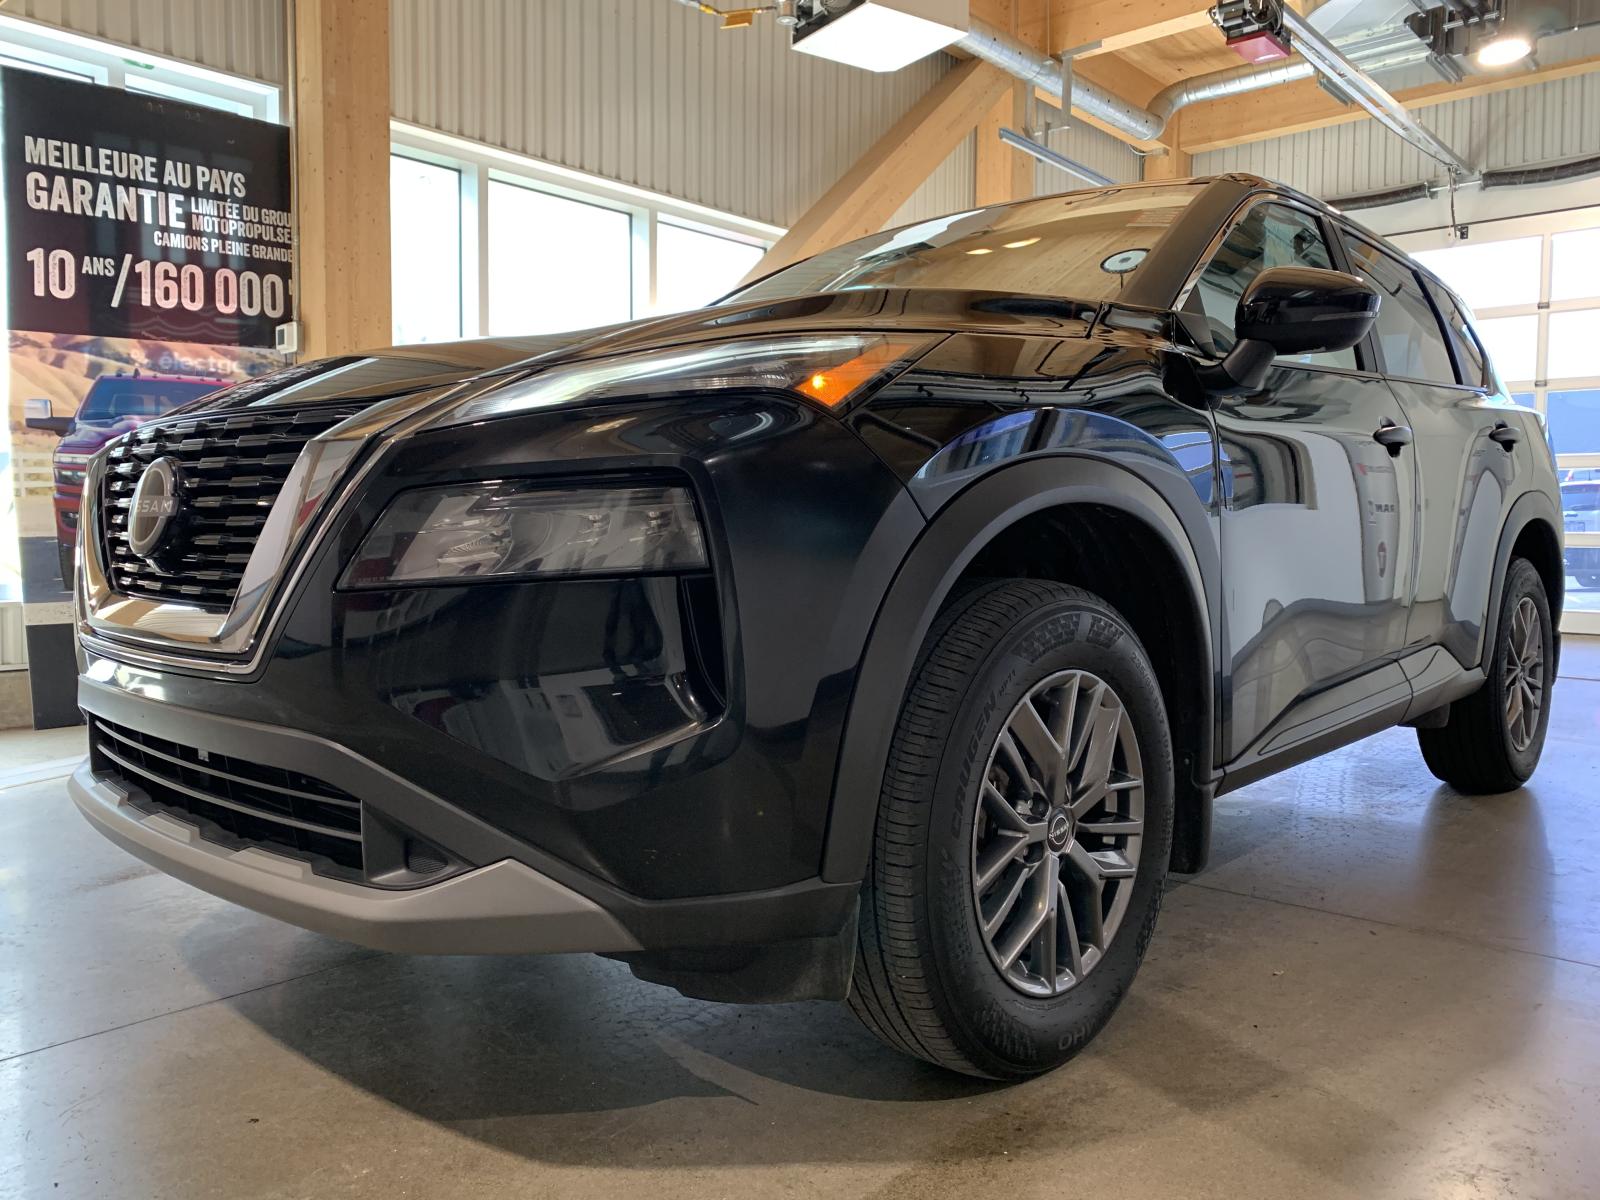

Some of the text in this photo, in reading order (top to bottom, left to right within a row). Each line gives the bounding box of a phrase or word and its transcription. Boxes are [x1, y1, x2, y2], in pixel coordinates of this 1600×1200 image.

[24, 135, 247, 198] MEILLEURE AU PAYS
[25, 171, 186, 229] GARANTIE
[191, 196, 241, 220] LIMITÉE
[242, 205, 259, 222] DU
[153, 230, 209, 252] CAMIONS
[210, 238, 251, 257] PLEINE
[26, 248, 76, 300] 10
[81, 255, 115, 278] ANS
[214, 268, 285, 319] 000
[136, 499, 174, 513] SSAN
